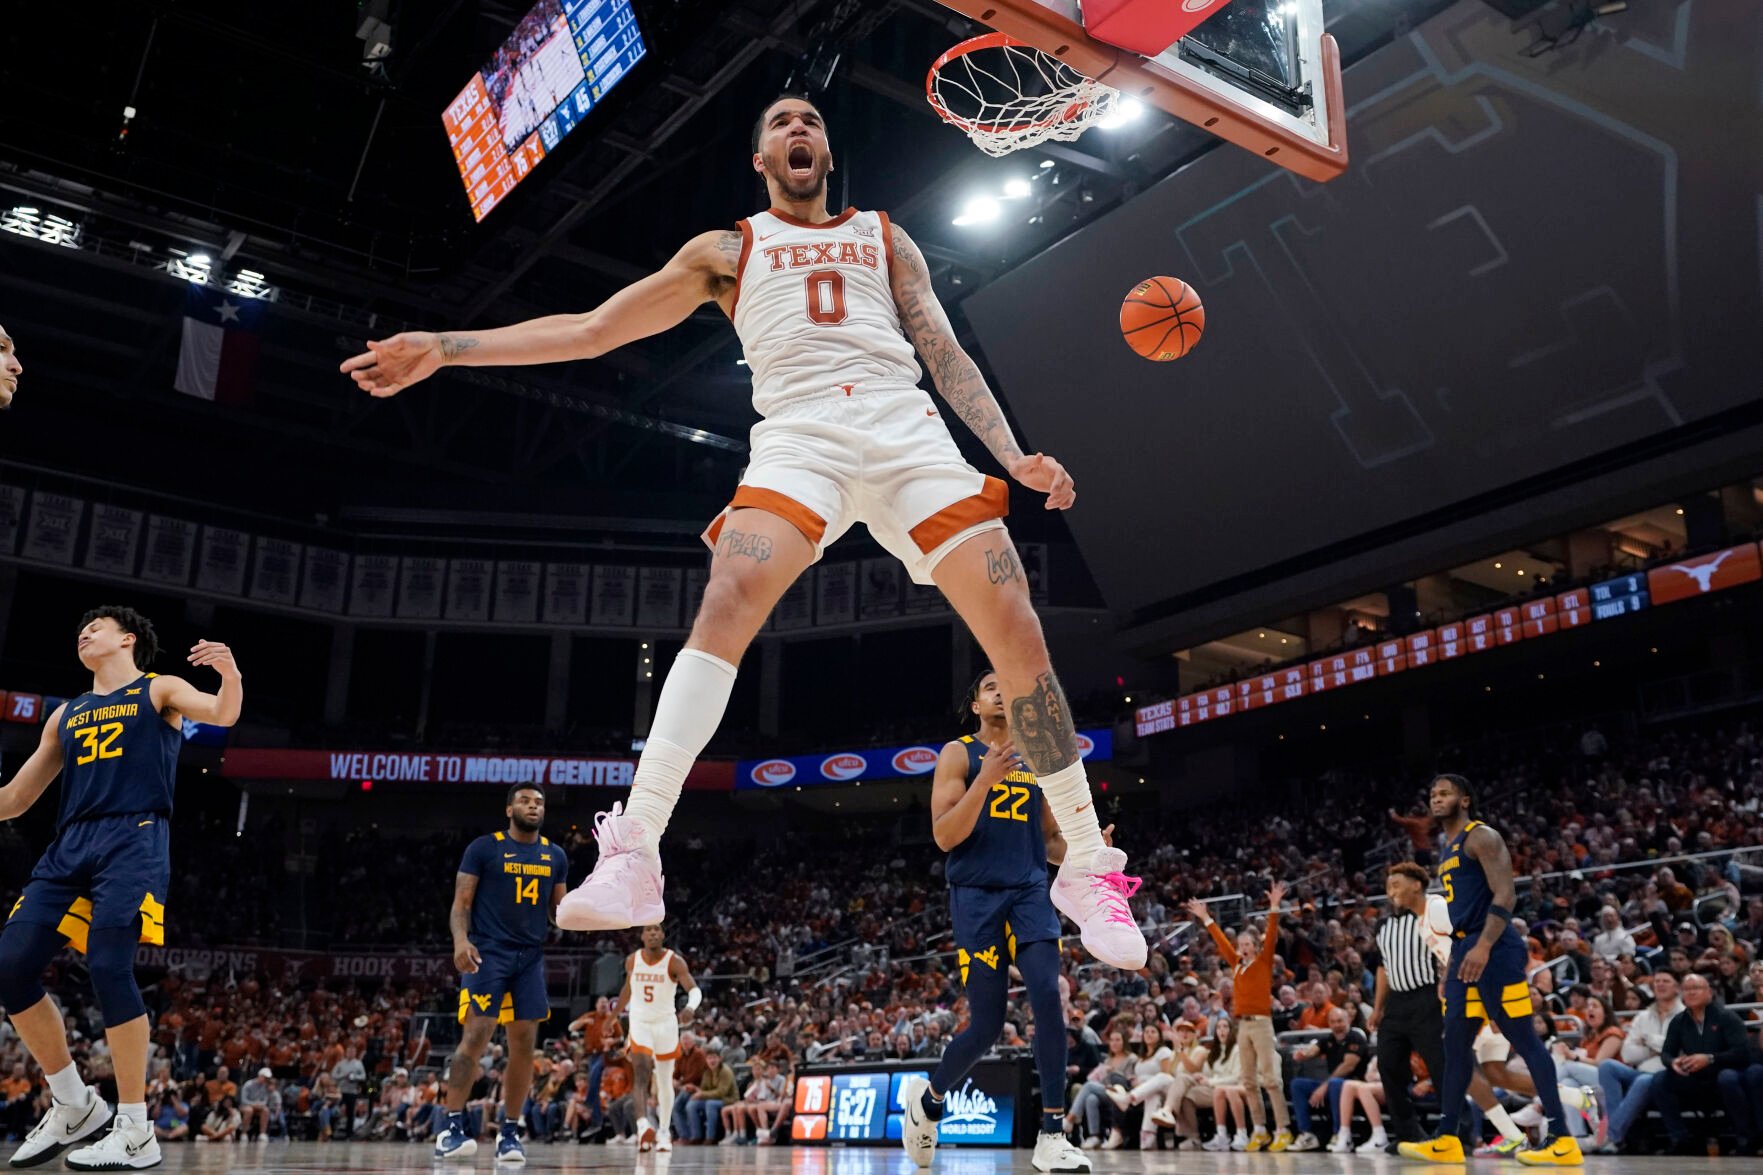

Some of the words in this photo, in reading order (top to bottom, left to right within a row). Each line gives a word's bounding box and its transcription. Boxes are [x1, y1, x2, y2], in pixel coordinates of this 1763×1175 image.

[450, 82, 480, 126] TEXAS
[575, 86, 591, 113] 45
[513, 151, 529, 177] 75
[764, 241, 879, 273] TEXAS
[804, 269, 849, 327] 0
[1595, 600, 1626, 620] FOULS
[13, 696, 35, 718] 75
[66, 711, 92, 729] WEST
[92, 703, 139, 722] VIRGINIA
[1139, 701, 1172, 721] TEXAS
[74, 721, 124, 766] 32
[330, 753, 431, 780] WELCOME
[436, 756, 461, 781] TO
[464, 757, 548, 783] MOODY
[550, 760, 635, 786] CENTER
[990, 784, 1030, 822] 22
[504, 862, 521, 874] WEST
[522, 864, 552, 877] VIRGINIA
[515, 876, 539, 905] 14
[332, 956, 396, 976] HOOK
[635, 973, 665, 984] TEXAS
[644, 985, 654, 1004] 5
[803, 1077, 823, 1112] 75
[838, 1088, 877, 1126] 5:27
